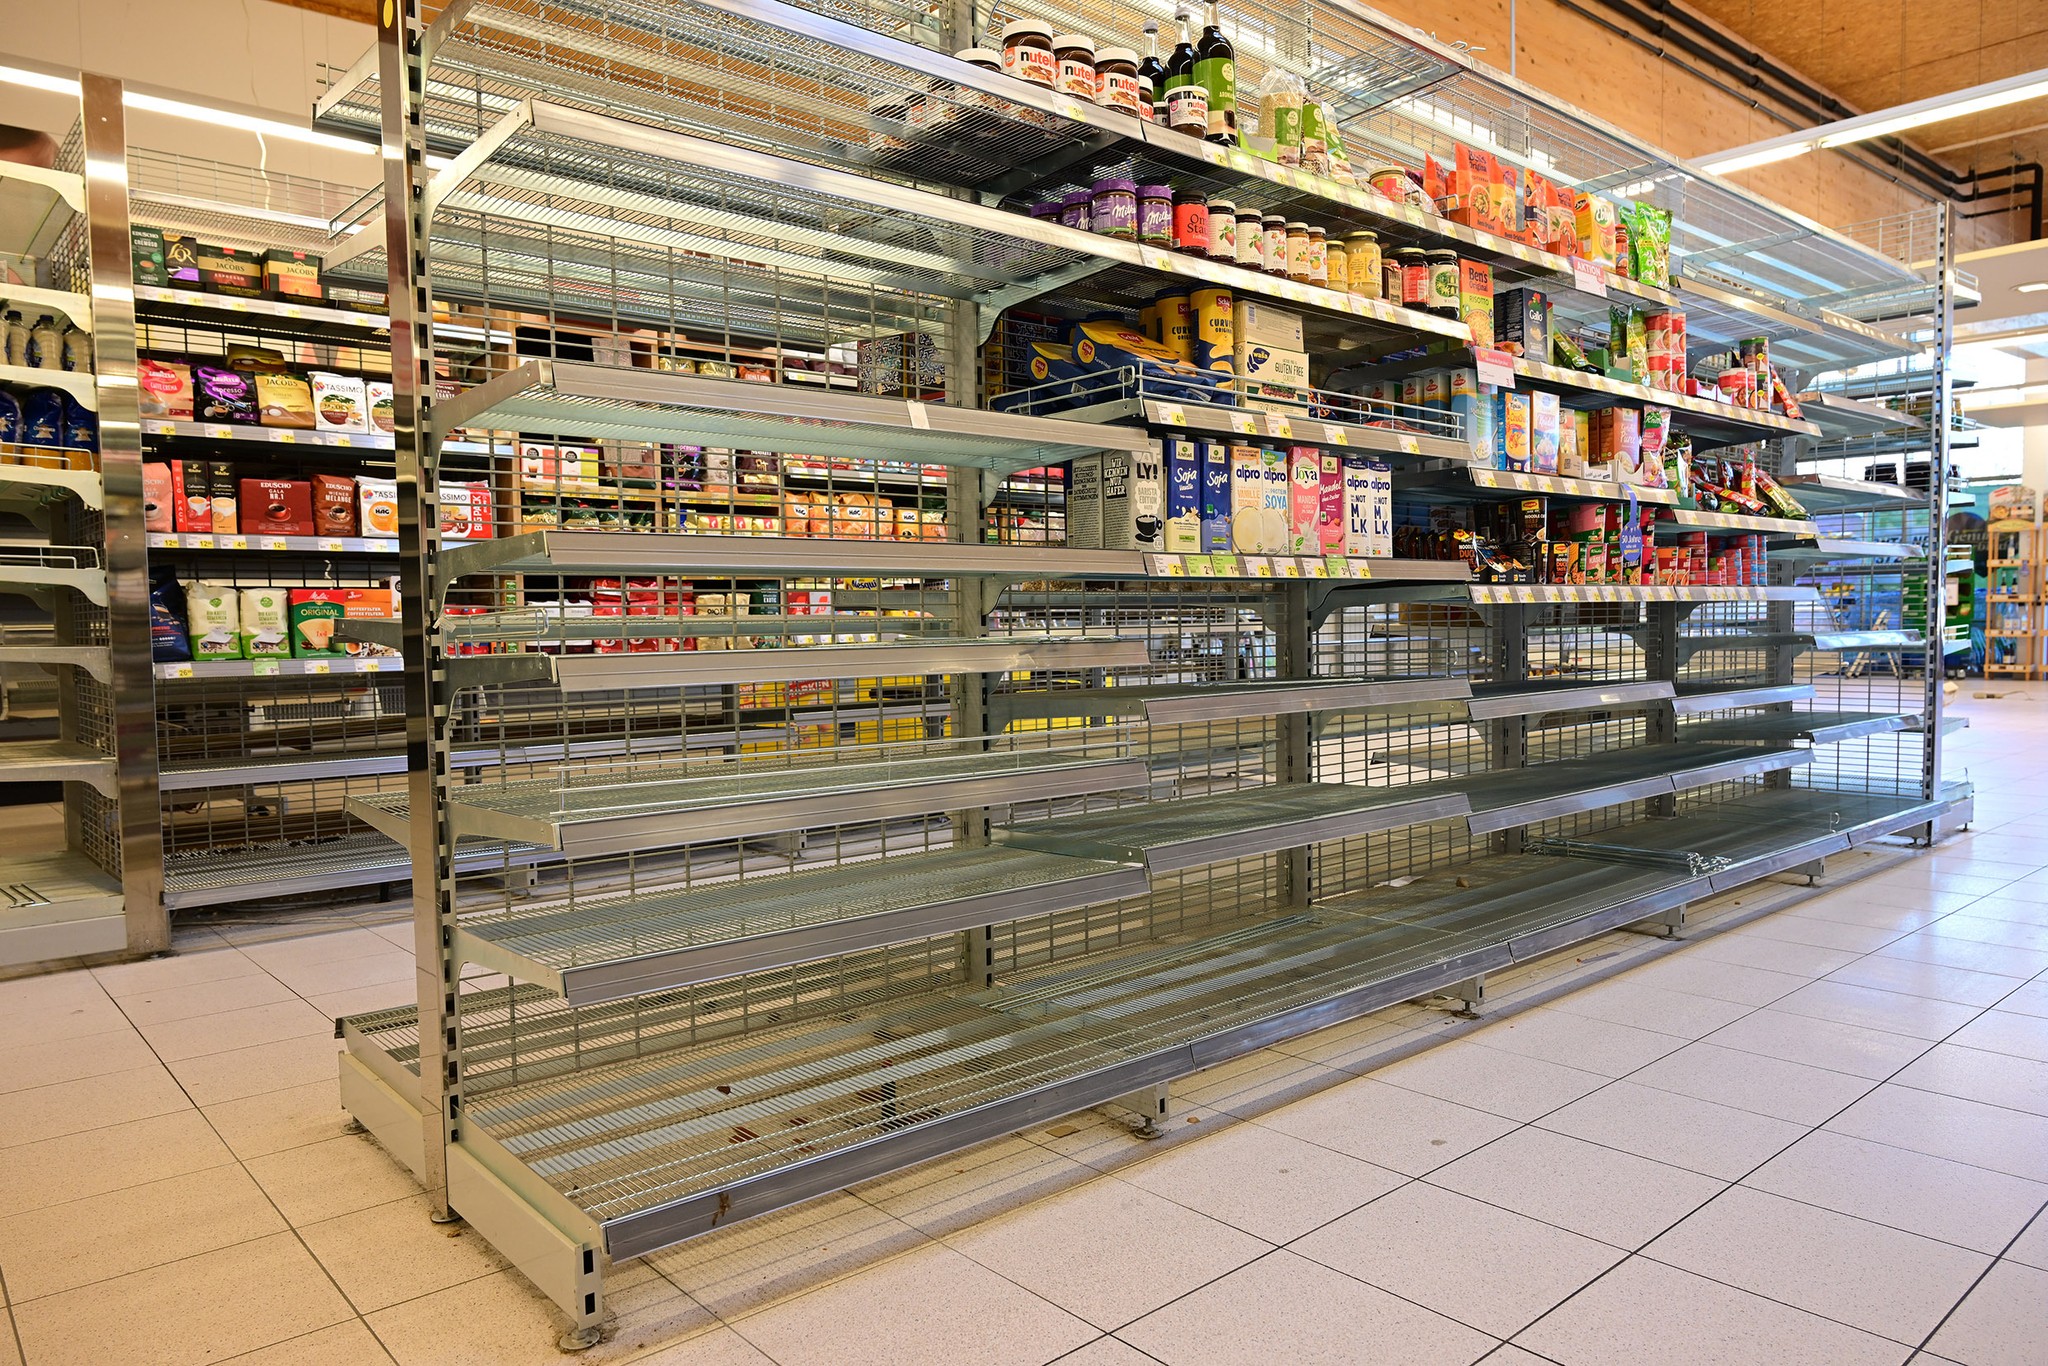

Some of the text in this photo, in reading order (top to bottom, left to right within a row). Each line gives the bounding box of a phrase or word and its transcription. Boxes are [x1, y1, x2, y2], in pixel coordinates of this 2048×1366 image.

[215, 262, 245, 273] JACOBS
[286, 266, 315, 277] JACOBS
[1576, 261, 1602, 277] AKTION
[1469, 266, 1489, 284] Ben's
[1469, 281, 1489, 293] Original
[1274, 362, 1305, 378] GLUTEN FREE
[265, 378, 298, 387] JACOBS
[211, 386, 243, 395] espresso
[325, 383, 364, 394] TASSIMO
[1110, 457, 1123, 468] WIR
[1104, 467, 1129, 478] KENNEN
[1136, 462, 1159, 480] LY!
[1174, 467, 1198, 485] Soja
[1236, 464, 1261, 483] alpro
[1263, 466, 1287, 485] alpro
[1295, 466, 1318, 484] Joya
[1108, 477, 1123, 487] NUR
[1206, 470, 1229, 489] Soja
[1346, 474, 1369, 491] alpro
[1370, 476, 1391, 493] alpro
[325, 482, 353, 491] EDUSCHO
[1106, 486, 1126, 497] HAFER
[1319, 479, 1342, 495] Mandel
[325, 494, 352, 504] MELANGE
[1264, 494, 1288, 510] SOYA
[1297, 494, 1317, 505] MANDEL
[1355, 494, 1367, 504] NOT
[1377, 496, 1388, 505] NOT
[1621, 535, 1642, 544] 50 Jahre
[300, 608, 340, 617] ORIGINAL
